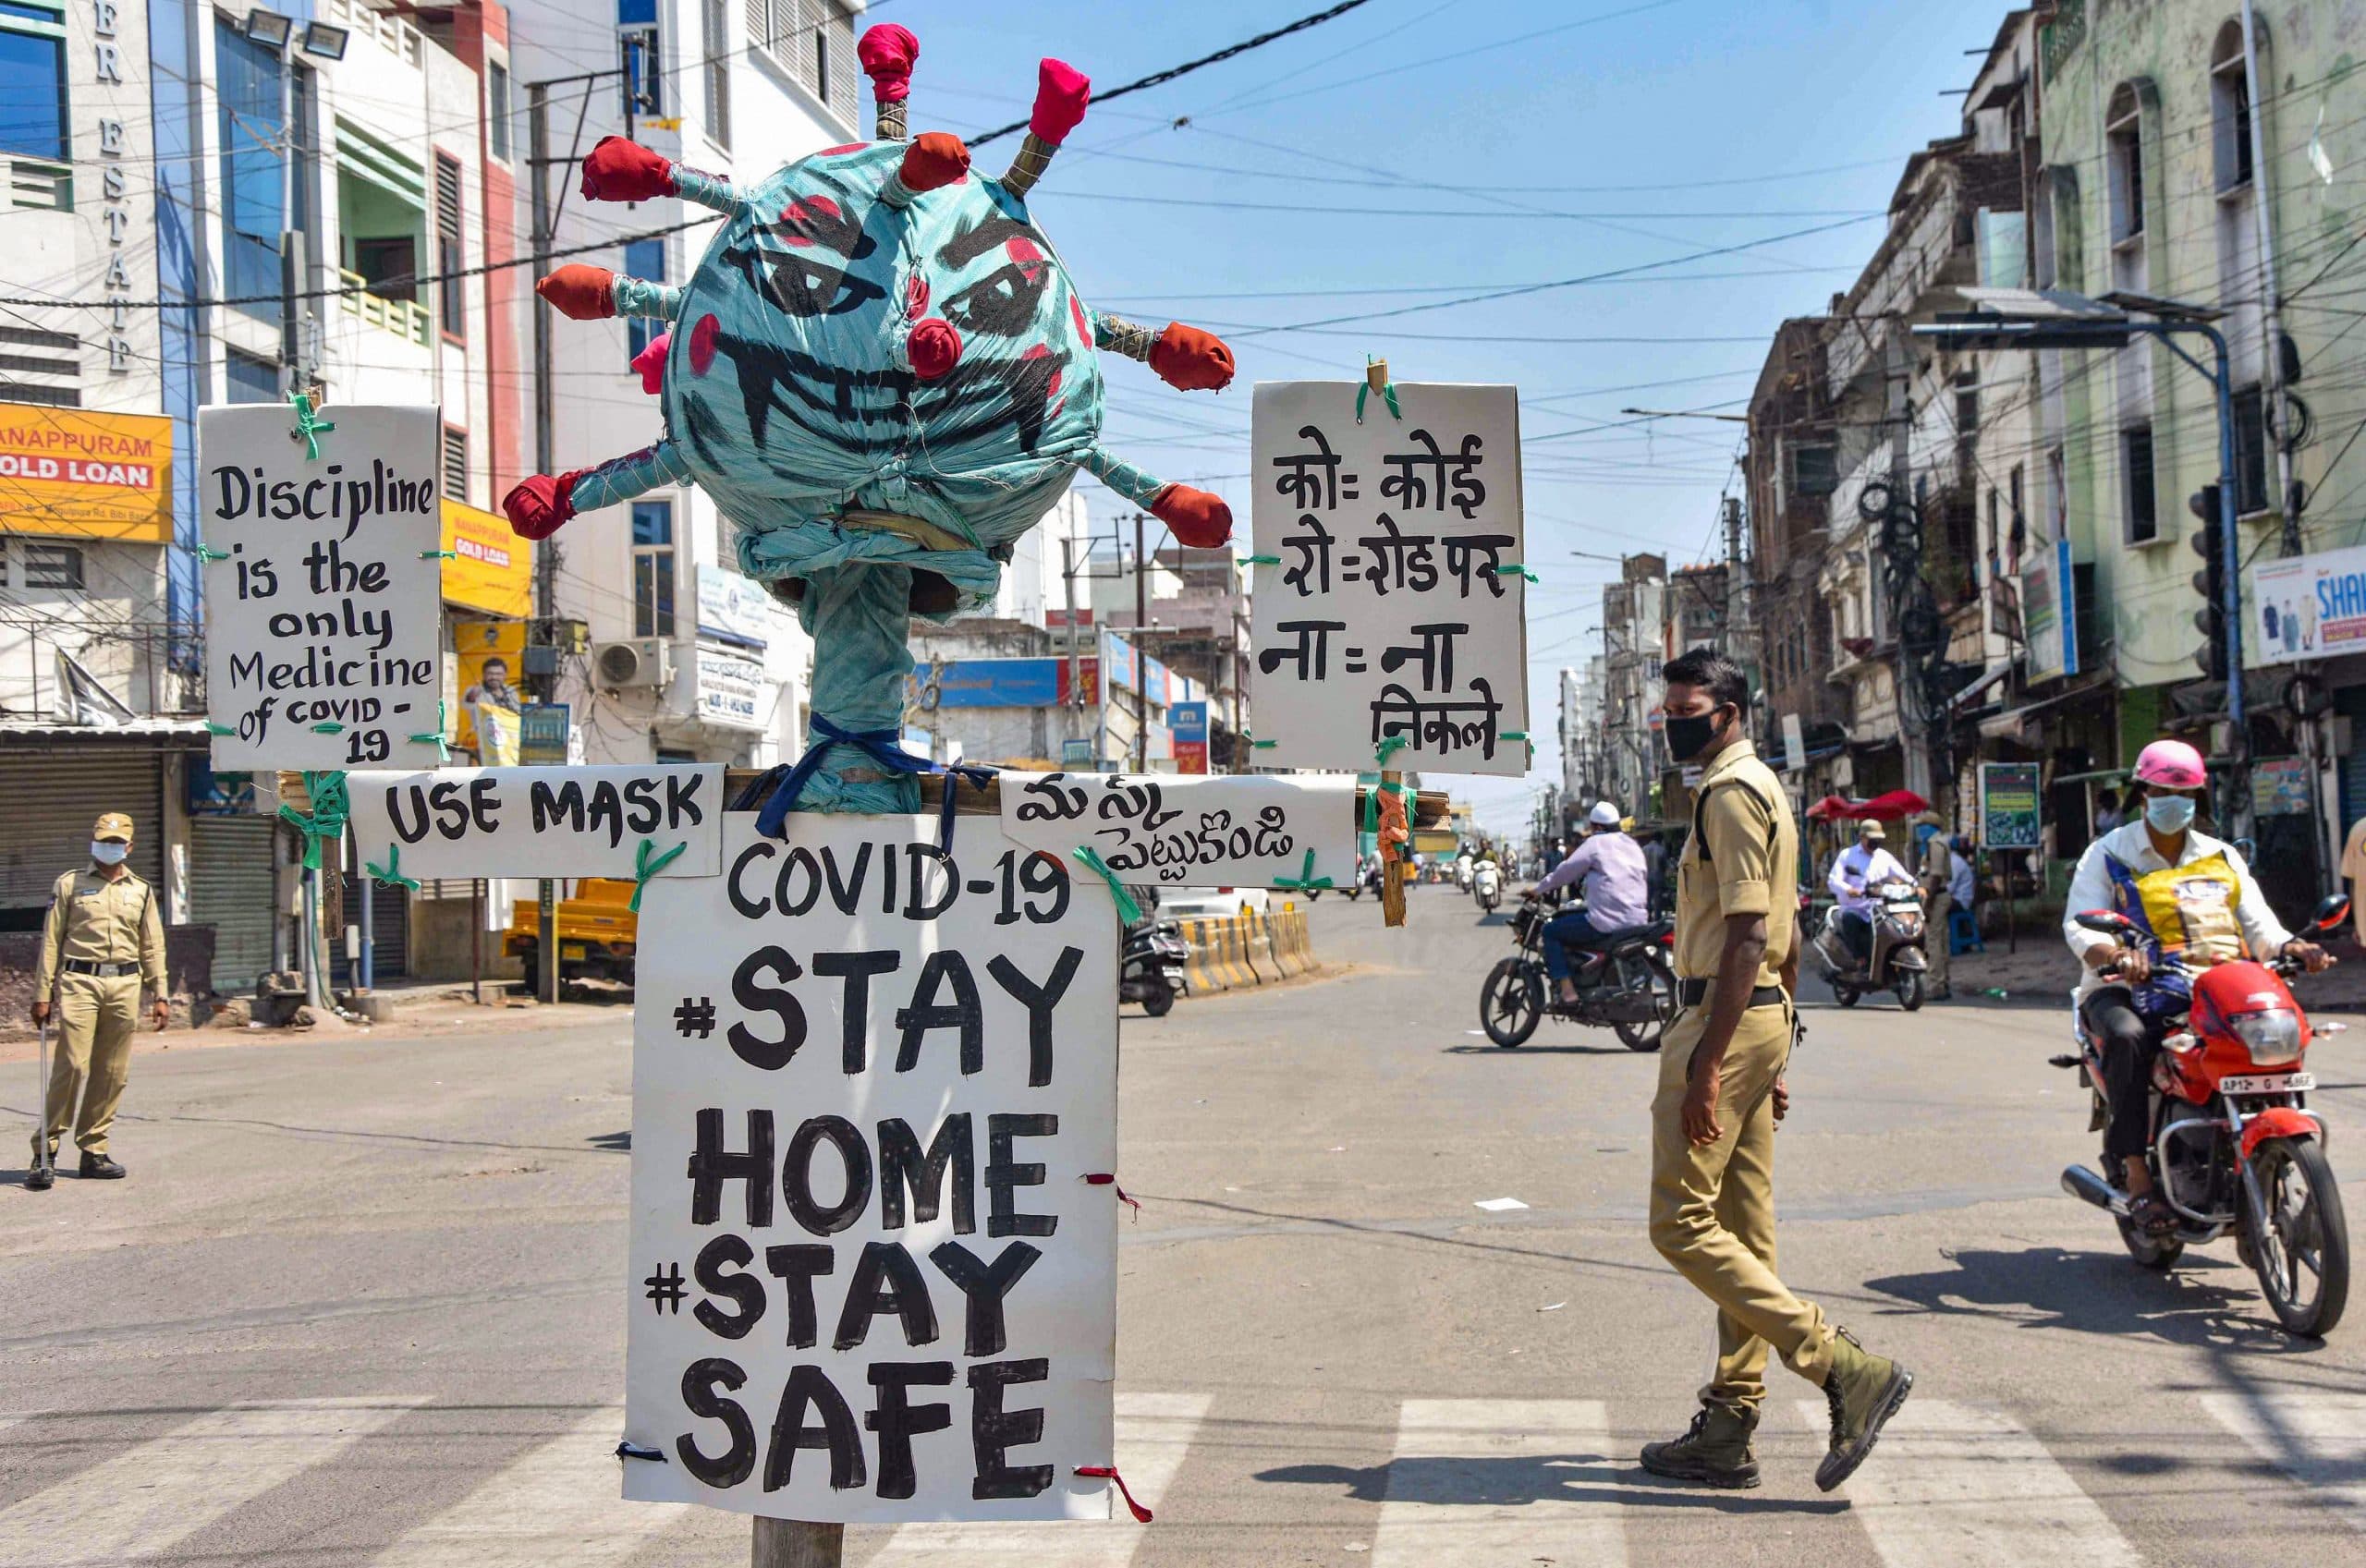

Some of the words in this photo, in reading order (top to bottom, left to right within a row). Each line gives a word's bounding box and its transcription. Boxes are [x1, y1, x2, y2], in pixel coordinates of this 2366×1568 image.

[100, 118, 131, 373] ESTATE
[68, 461, 148, 486] LOAN
[211, 458, 433, 542] Discipline
[1380, 429, 1485, 519] कोई
[233, 542, 278, 601] is
[301, 535, 391, 595] the
[2316, 572, 2366, 620] SHA
[268, 598, 393, 653] only
[1380, 623, 1474, 696] ना
[229, 643, 432, 692] Medicine
[239, 696, 280, 748] of
[345, 729, 390, 764] 19
[1370, 674, 1504, 761] निकले
[385, 778, 502, 846] USE
[530, 772, 703, 851] MASK
[727, 842, 1070, 925] COVID-19
[687, 1107, 1059, 1239] HOME
[676, 1354, 1055, 1501] SAFE
